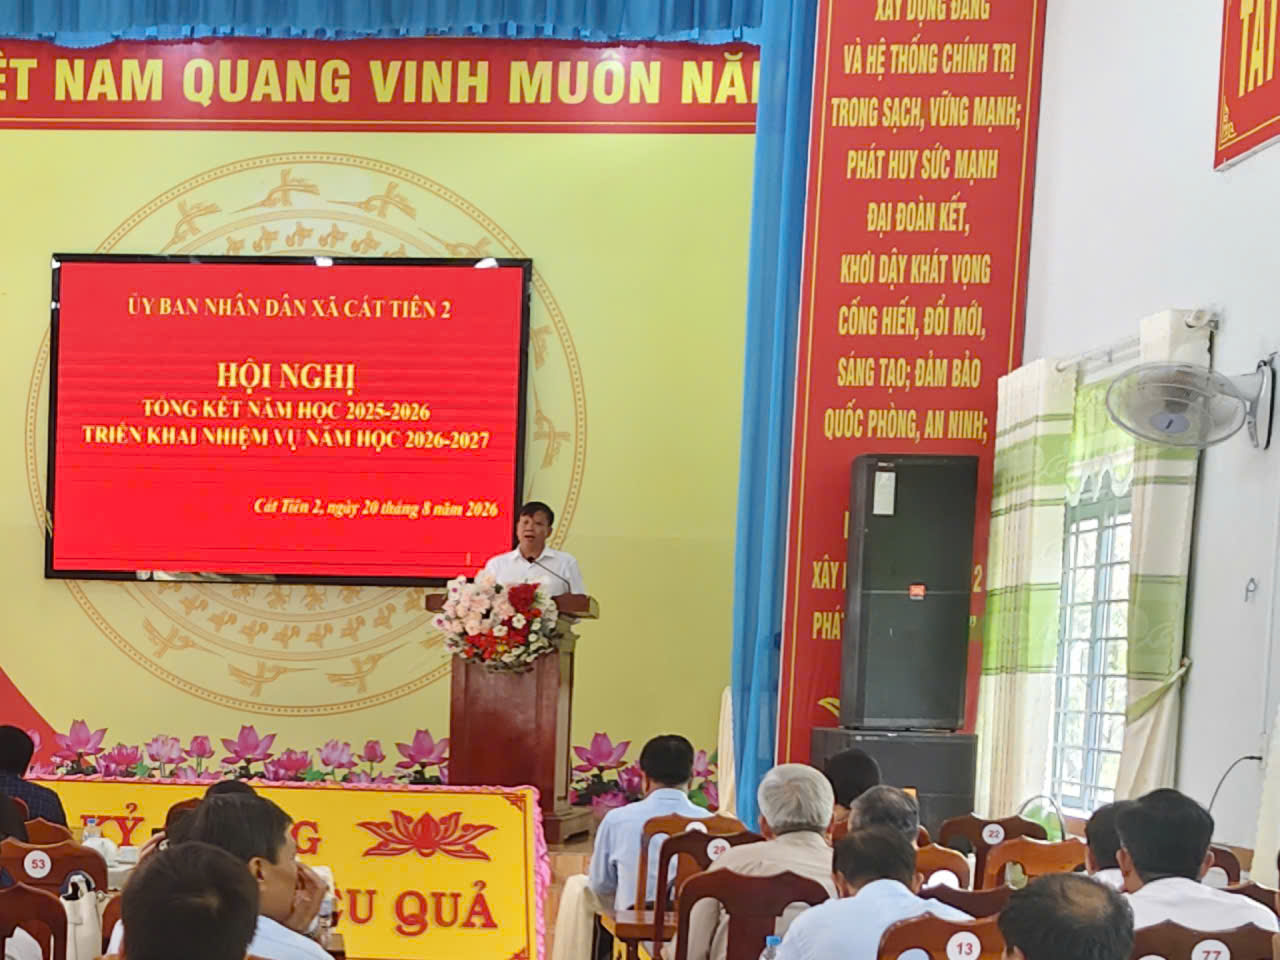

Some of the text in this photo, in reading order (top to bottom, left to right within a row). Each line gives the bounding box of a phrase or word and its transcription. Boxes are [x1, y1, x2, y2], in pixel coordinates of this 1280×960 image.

[55, 58, 163, 101] NAM
[182, 58, 351, 108] QUANG
[369, 59, 489, 103] VINH
[508, 49, 661, 105] MUÔN
[680, 52, 760, 104] NĂ
[843, 33, 1017, 82] VÀ HỆ THỐNG CHÍNH TRỊ
[831, 89, 1022, 133] TRONG SẠCH, VỮNG MẠNH;
[846, 142, 999, 186] PHÁT HUY SỨC MẠNH
[866, 191, 970, 238] ĐẠI ĐOÀN KẾT,
[878, 247, 908, 291] DẬY
[910, 247, 949, 284] KHÁT
[951, 253, 991, 291] VỌNG
[159, 297, 199, 316] BAN
[204, 291, 260, 317] NHÂN
[265, 292, 307, 317] DÂN
[311, 294, 339, 318] XÃ
[343, 294, 385, 318] CÁT
[389, 293, 437, 319] TIÊN
[440, 301, 452, 319] 2
[838, 293, 987, 341] CỐNG HIẾN, ĐỔI MỚI,
[217, 356, 356, 397] HỘI NGHỊ
[837, 349, 981, 394] SÁNG TẠO; ĐẢM BẢO
[248, 396, 293, 420] NĂM
[297, 400, 342, 424] HỌC
[345, 401, 431, 421] 2025-2026
[824, 398, 988, 445] QUỐC PHÒNG, AN NINH;
[146, 425, 198, 446] KHAI
[202, 425, 268, 451] NHIỆM
[273, 427, 302, 451] VỤ
[306, 425, 352, 447] NĂM
[356, 428, 401, 453] HỌC
[405, 429, 490, 449] 2026-2027
[253, 497, 279, 513] Cát
[327, 499, 361, 519] ngày
[362, 499, 380, 515] 20
[380, 499, 420, 520] tháng
[421, 500, 432, 516] 8
[432, 501, 464, 516] năm
[465, 500, 499, 517] 2026
[811, 553, 839, 589] XÂY
[811, 605, 845, 640] PHÁ
[31, 857, 47, 870] 53
[394, 879, 499, 937] QUẢ
[956, 941, 974, 957] 13
